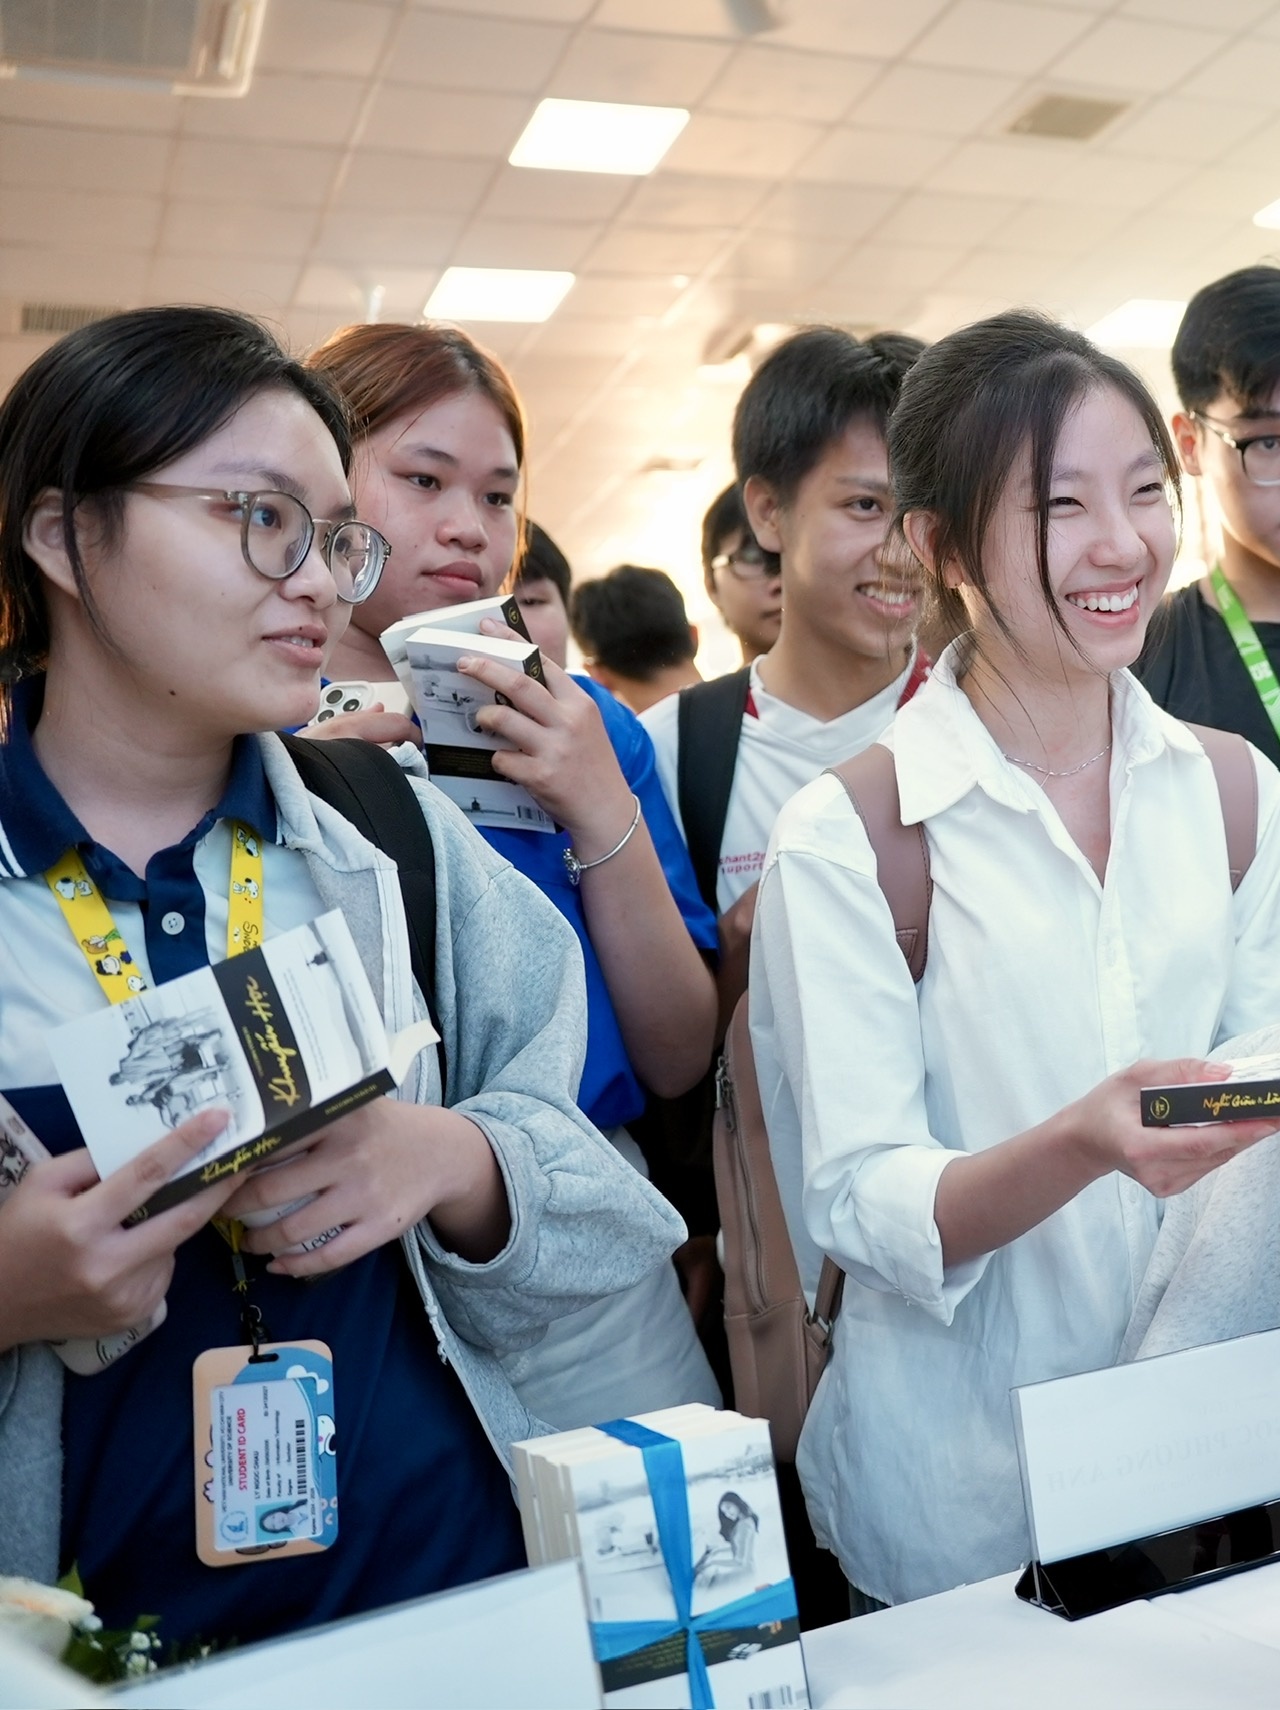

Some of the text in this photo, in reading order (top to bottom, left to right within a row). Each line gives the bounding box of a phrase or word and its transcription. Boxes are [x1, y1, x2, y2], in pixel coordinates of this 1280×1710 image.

[236, 1408, 248, 1491] STUDENT ID CARD
